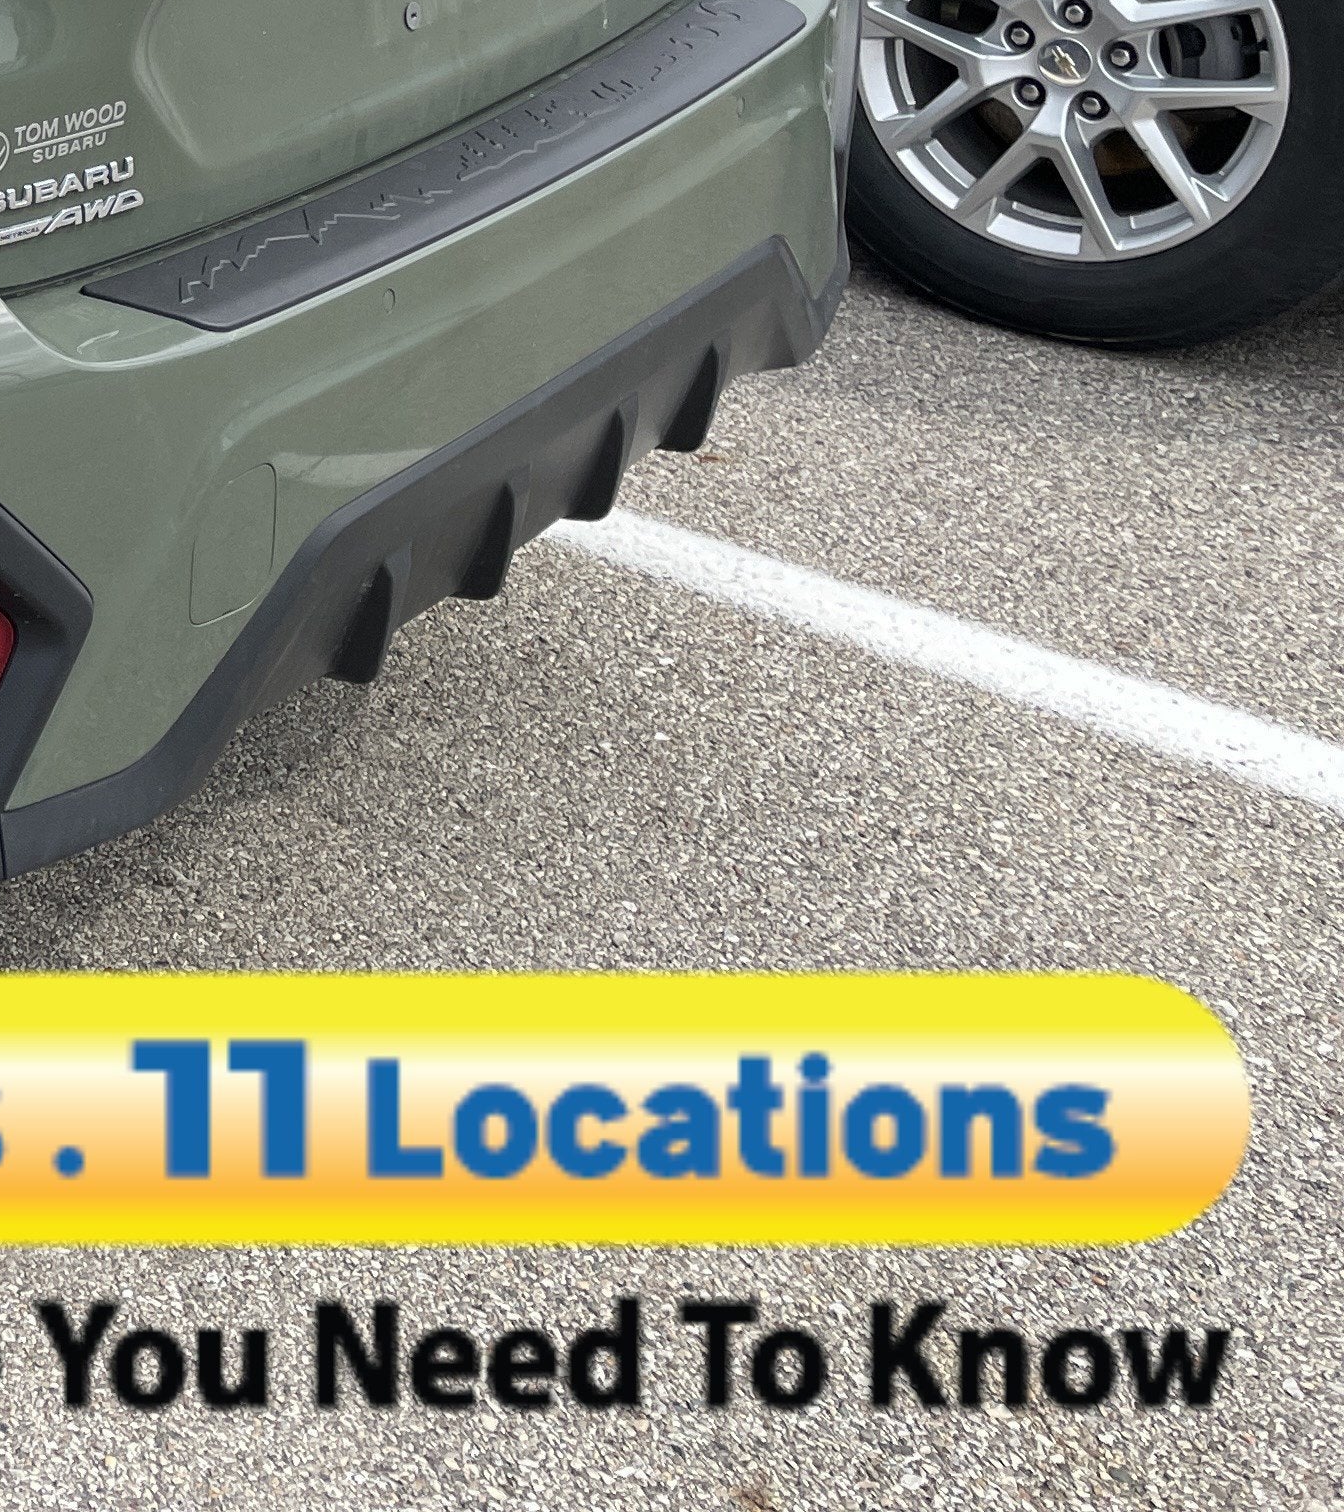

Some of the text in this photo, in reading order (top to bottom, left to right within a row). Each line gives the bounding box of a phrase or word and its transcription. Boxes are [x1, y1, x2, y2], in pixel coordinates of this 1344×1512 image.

[14, 100, 127, 146] TOM WOOD
[31, 131, 108, 164] SUBARU
[44, 189, 145, 234] AWD
